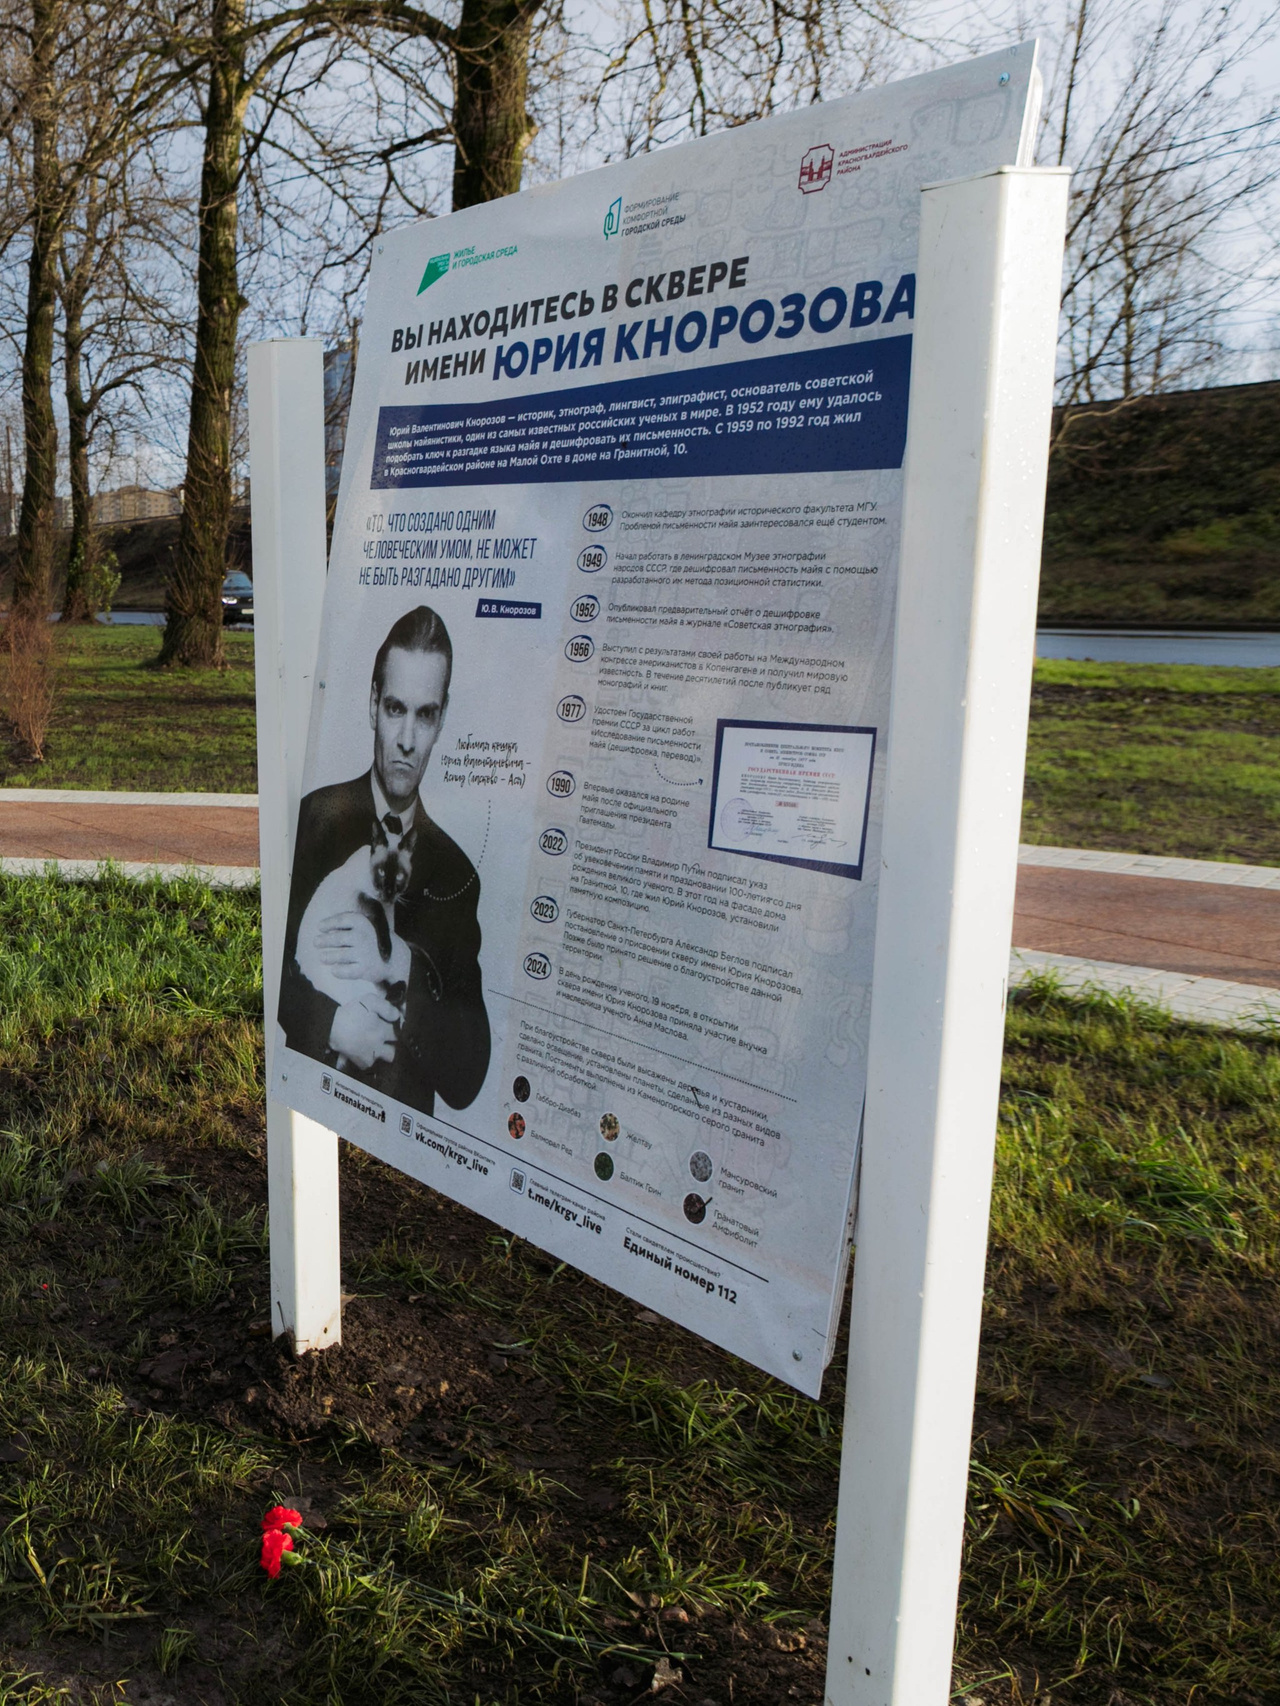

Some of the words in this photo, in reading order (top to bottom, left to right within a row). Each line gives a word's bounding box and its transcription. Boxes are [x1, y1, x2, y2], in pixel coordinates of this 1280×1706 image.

[623, 205, 668, 225] КОМФОРТНОЙ
[624, 192, 680, 214] ФОРМИРОВАНИЕ
[621, 219, 660, 237] ГОРОДСКОЙ
[661, 214, 686, 227] СРЕДЫ
[452, 261, 457, 270] И
[458, 251, 495, 268] ГОРОДСКАЯ
[495, 245, 518, 258] СРЕДА
[453, 245, 476, 260] ЖИЛЬЕ
[391, 324, 424, 353] ВЫ
[427, 289, 595, 346] НАХОДИТЕСЬ
[601, 284, 618, 313] В
[625, 256, 750, 308] СКВЕРЕ
[492, 327, 606, 381] ЮРИЯ
[613, 272, 916, 363] КНОРОЗОВА
[405, 348, 486, 386] ИМЕНИ
[389, 425, 410, 437] Юрий
[411, 420, 464, 434] Валентинович
[465, 415, 506, 427] Кнорозов
[517, 410, 556, 422] историк,
[558, 402, 606, 417] этнограф,
[608, 398, 656, 412] лингвист,
[659, 390, 727, 406] эпиграфист,
[731, 381, 802, 398] основатель
[805, 369, 874, 390] советской
[387, 440, 413, 450] школы
[413, 435, 464, 447] майянистики,
[465, 432, 486, 442] один
[487, 431, 497, 439] из
[498, 428, 526, 438] самых
[528, 423, 576, 435] известных
[578, 416, 636, 433] российских
[638, 412, 678, 427] ученых
[680, 411, 688, 420] в
[690, 408, 722, 420] мире.
[725, 404, 734, 416] В
[738, 401, 764, 415] 1952
[767, 400, 796, 412] году
[799, 397, 824, 410] ему
[826, 391, 882, 408] удалось
[385, 452, 424, 464] подобрать
[425, 450, 445, 460] ключ
[446, 450, 451, 458] к
[452, 446, 488, 459] разгадке
[490, 444, 516, 454] языка
[518, 440, 540, 451] майя
[542, 441, 548, 449] и
[549, 435, 617, 450] дешифровать
[618, 433, 631, 443] их
[633, 426, 711, 441] письменность.
[715, 422, 724, 434] С
[727, 420, 754, 433] 1959
[756, 420, 772, 430] по
[776, 415, 805, 429] 1992
[808, 415, 830, 427] год
[833, 412, 862, 424] жил
[384, 469, 389, 477] в
[390, 462, 464, 477] Красногвардейском
[465, 459, 496, 472] районе
[497, 459, 508, 468] на
[509, 455, 538, 467] Малой
[540, 454, 563, 465] Охте
[564, 454, 571, 463] в
[572, 452, 597, 464] доме
[599, 451, 611, 460] на
[613, 444, 670, 461] Гранитной,
[674, 443, 688, 454] 10.
[388, 513, 406, 532] ЧТО
[407, 510, 454, 533] СОЗДАНО
[455, 509, 496, 533] ОДНИМ
[588, 512, 608, 527] 1948
[621, 510, 653, 519] Окончил
[654, 509, 687, 519] кафедру
[688, 507, 736, 517] этнографии
[738, 506, 801, 516] исторического
[803, 504, 854, 515] факультета
[363, 539, 438, 559] ЧЕЛОВЕЧЕСКИМ
[439, 539, 473, 560] УМОМ,
[476, 538, 492, 559] НЕ
[492, 538, 537, 559] МОЖЕТ
[582, 553, 602, 568] 1949
[615, 552, 637, 560] Начал
[638, 552, 672, 562] работать
[680, 553, 742, 562] ленинградском
[744, 552, 770, 562] Музее
[772, 552, 826, 562] этнографии
[358, 567, 372, 585] НЕ
[372, 566, 399, 586] БЫТЬ
[400, 567, 461, 589] РАЗГАДАНО
[461, 567, 516, 590] ДРУГИМ»
[575, 602, 596, 617] 1952
[570, 642, 590, 657] 1956
[562, 703, 582, 718] 1977
[594, 706, 627, 717] Удостоен
[628, 709, 693, 725] Государственной
[551, 777, 571, 793] 1990
[542, 834, 563, 851] 2022
[534, 901, 554, 919] 2023
[564, 921, 617, 942] постановление
[624, 938, 670, 957] присвоении
[671, 951, 699, 966] скверу
[700, 960, 726, 973] имени
[728, 966, 752, 980] Юрия
[566, 908, 606, 927] Губернатор
[607, 920, 674, 946] Санкт-Петербурга
[675, 939, 719, 959] Александр
[720, 951, 750, 967] Беглов
[752, 961, 793, 978] подписал
[527, 957, 547, 976] 2024
[557, 979, 581, 992] сквера
[582, 988, 604, 999] имени
[605, 993, 626, 1007] Юрия
[627, 1000, 668, 1021] Кнорозова
[669, 1016, 702, 1033] приняла
[704, 1028, 737, 1044] участие
[738, 1039, 768, 1055] внучка
[561, 992, 602, 1011] наследница
[602, 1006, 632, 1021] ученого
[633, 1015, 653, 1028] Анна
[334, 1088, 386, 1123] krasnakarta.ru
[535, 1092, 581, 1118] Габбро-Диабаз
[530, 1130, 560, 1149] Балморал
[561, 1144, 573, 1157] Ред
[626, 1131, 653, 1150] Желтау
[415, 1132, 489, 1176] vk.com/krgv_live
[620, 1171, 644, 1189] Балтик
[645, 1183, 662, 1196] Грин
[718, 1180, 745, 1196] гранит
[720, 1167, 778, 1198] Мансуровский
[528, 1188, 602, 1234] t.me/krgv_live
[714, 1209, 759, 1237] Гранатовый
[712, 1221, 758, 1248] Амфиболит
[623, 1236, 672, 1271] Единый
[674, 1265, 715, 1294] номер
[718, 1285, 737, 1304] 112
